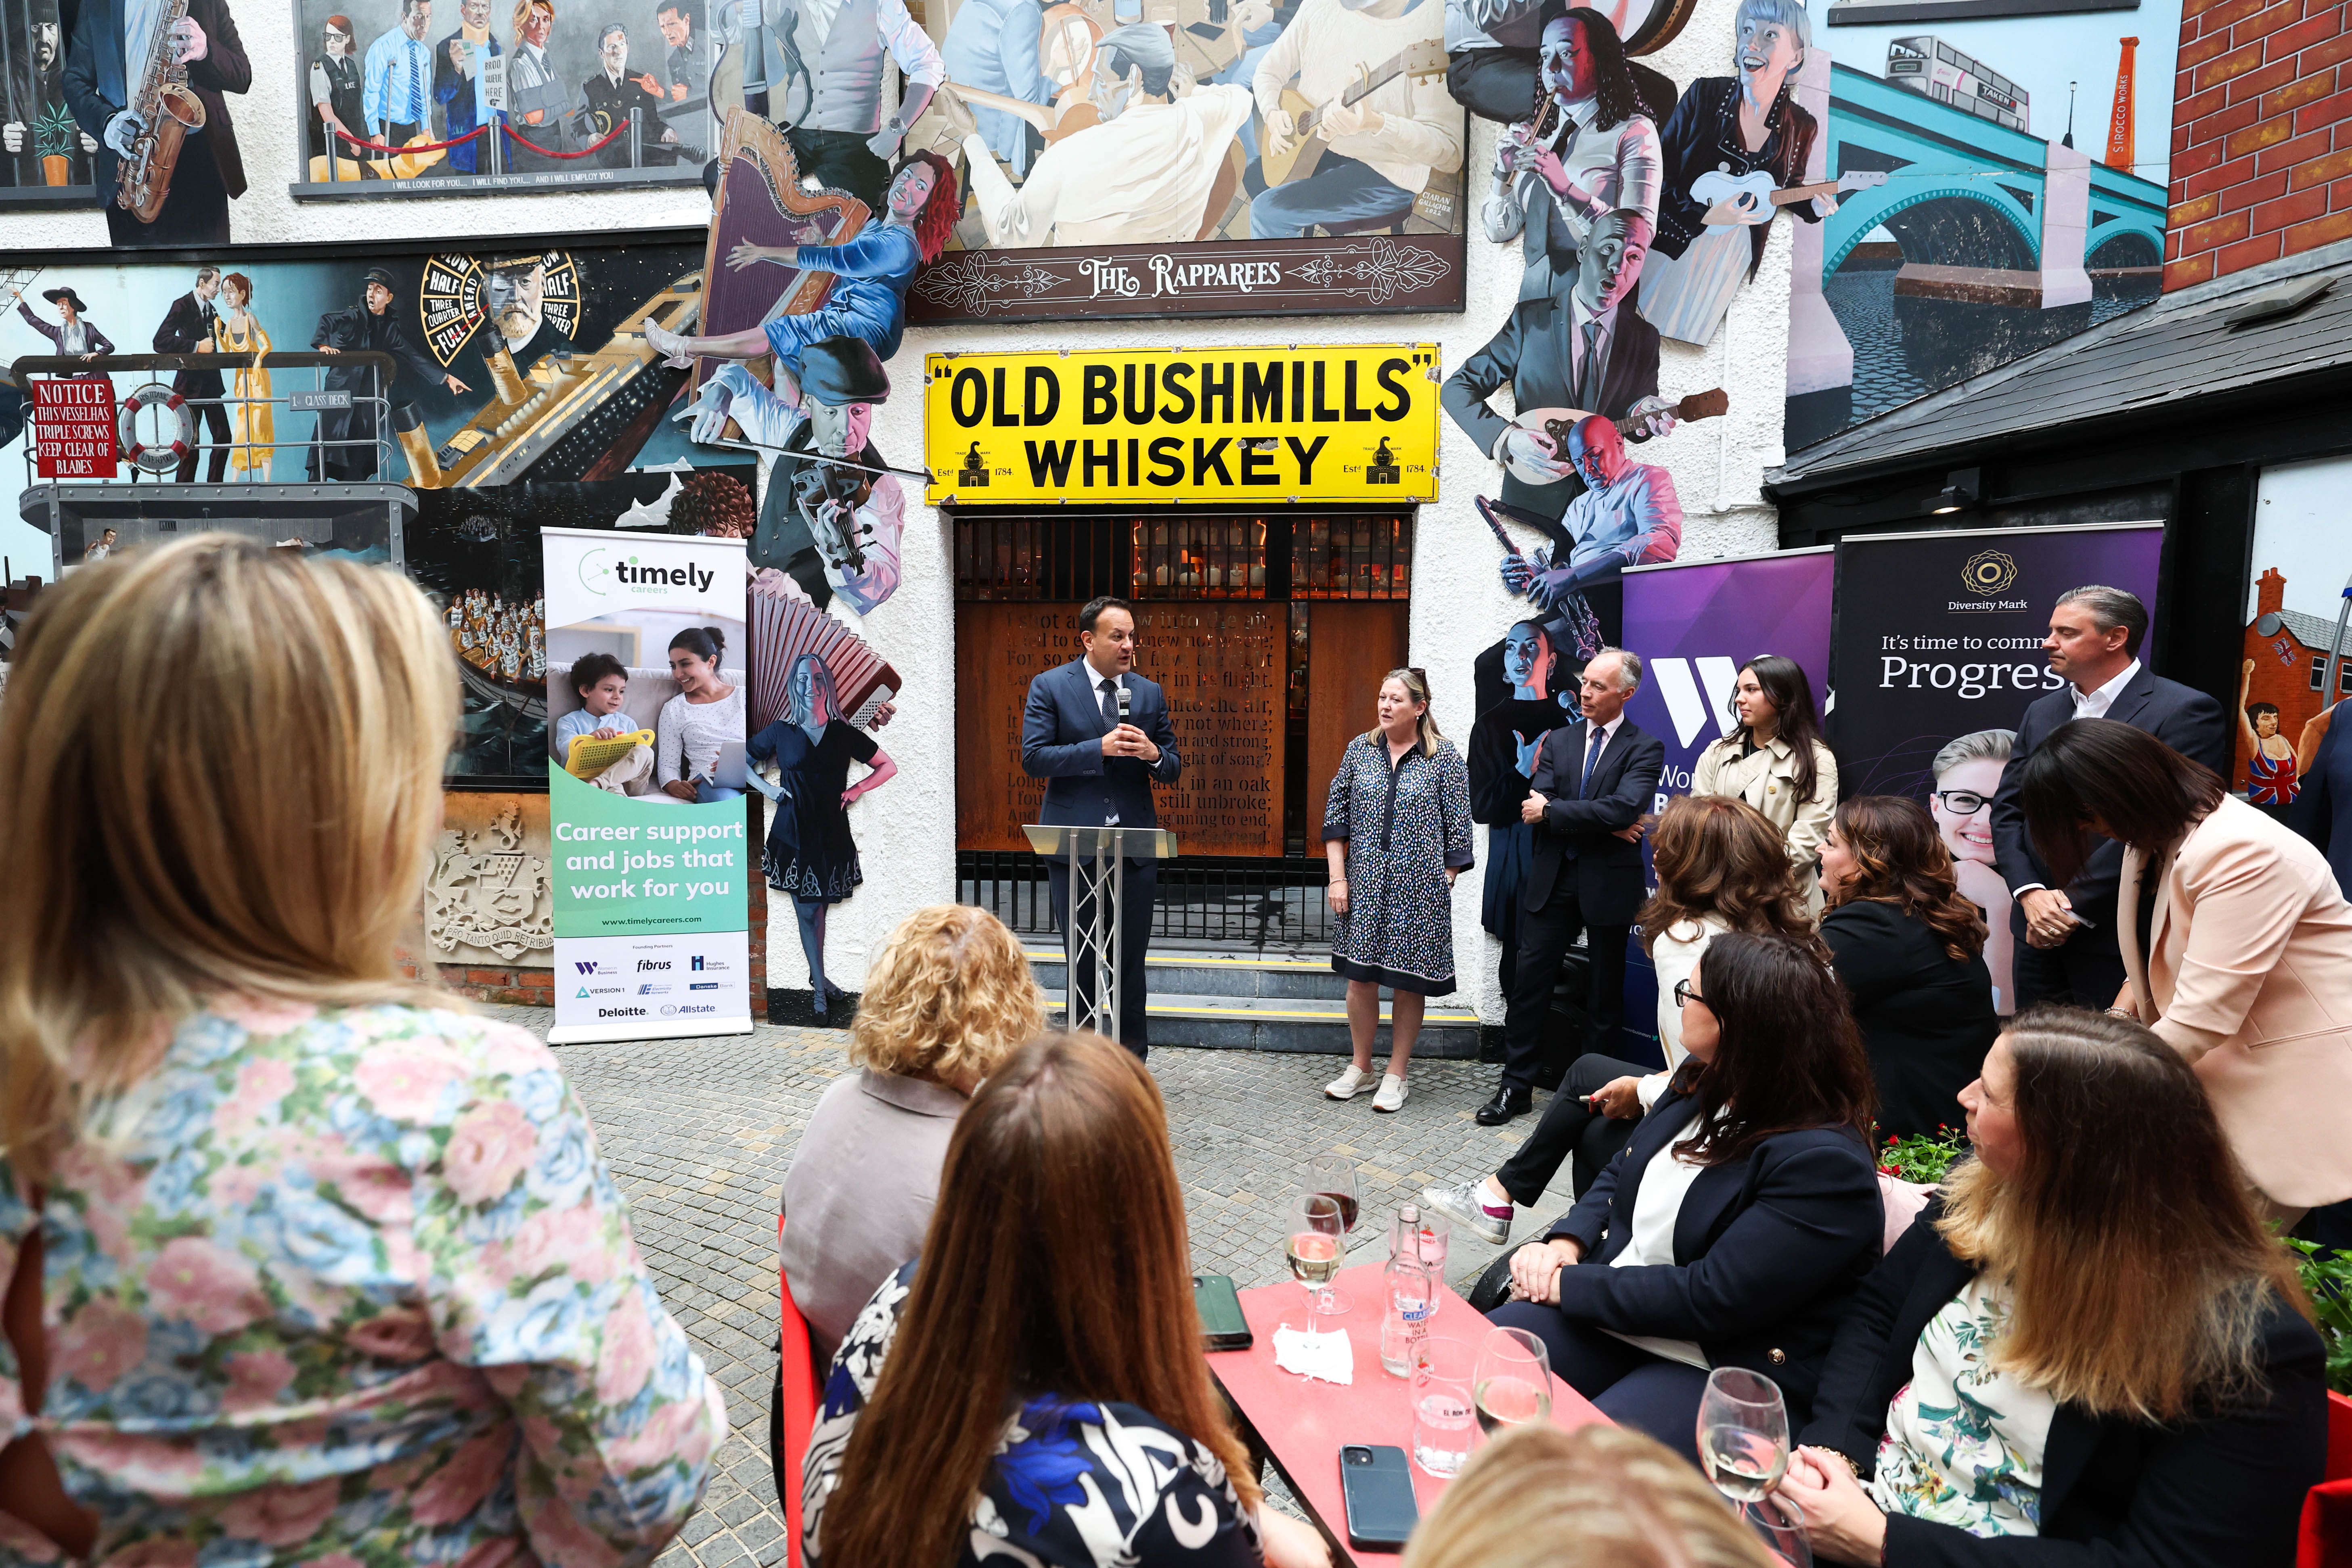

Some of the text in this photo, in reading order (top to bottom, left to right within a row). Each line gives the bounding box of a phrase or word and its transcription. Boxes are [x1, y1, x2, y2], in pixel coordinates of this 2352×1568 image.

[485, 73, 503, 83] QUEUE
[485, 87, 503, 97] HERE
[1982, 86, 2010, 105] TAKEN
[2113, 74, 2128, 153] SIROCCO WORKS
[412, 180, 431, 188] LOOK
[431, 180, 445, 188] FOR
[536, 175, 549, 183] AND
[554, 174, 570, 182] WILL
[571, 173, 598, 181] EMPLOY
[599, 172, 614, 180] YOU
[1418, 198, 1451, 213] GALLAGHER
[1422, 191, 1451, 205] CIARAN
[1424, 207, 1441, 216] 2022
[429, 270, 459, 294] HALF
[1079, 254, 1281, 299] THE RAPPAREES
[430, 299, 453, 312] THREE
[464, 278, 478, 319] AHEAD
[428, 307, 460, 327] QUARTER
[544, 303, 568, 318] THREE
[436, 324, 466, 356] FULL
[39, 384, 106, 404] NOTICE
[305, 395, 327, 406] CLASS
[329, 394, 349, 405] DECK
[37, 406, 110, 421] THIS VESSEL HAS
[37, 425, 109, 440] TRIPLE SCREWS
[38, 442, 109, 457] KEEP CLEAR OF
[141, 452, 174, 464] LIVERPOOL
[1024, 435, 1330, 488] WHISKEY
[56, 460, 93, 475] BLADES
[616, 556, 714, 593] timely
[631, 586, 668, 594] careers
[1948, 599, 2027, 611] Diversity Mark
[1160, 611, 1198, 629] into
[1053, 634, 1068, 647] to
[1913, 635, 1958, 650] time
[1962, 636, 1983, 650] to
[1987, 636, 2048, 650] comm
[1043, 653, 1062, 666] so
[1174, 671, 1191, 687] in
[1197, 671, 1218, 687] its
[1879, 656, 2075, 699] Progres
[1211, 697, 1238, 713] the
[1185, 717, 1212, 731] not
[1217, 717, 1272, 733] where;
[1007, 732, 1022, 745] Fo
[1192, 734, 1218, 747] and
[1211, 752, 1225, 765] of
[1190, 775, 1206, 791] in
[1213, 778, 1233, 791] an
[1239, 776, 1271, 792] oak
[1018, 790, 1043, 806] fou
[1160, 793, 1191, 808] still
[1197, 793, 1271, 812] unbroke;
[1008, 808, 1271, 829] And eginning to end,
[556, 821, 743, 844] Career support
[566, 849, 734, 874] and jobs that
[570, 878, 729, 901] work for you
[602, 916, 702, 925] www.timelycareers.com
[446, 927, 554, 947] PRO TANTO QUID RETRIBUA
[637, 959, 672, 973] fibrus
[678, 1005, 716, 1014] Allstate
